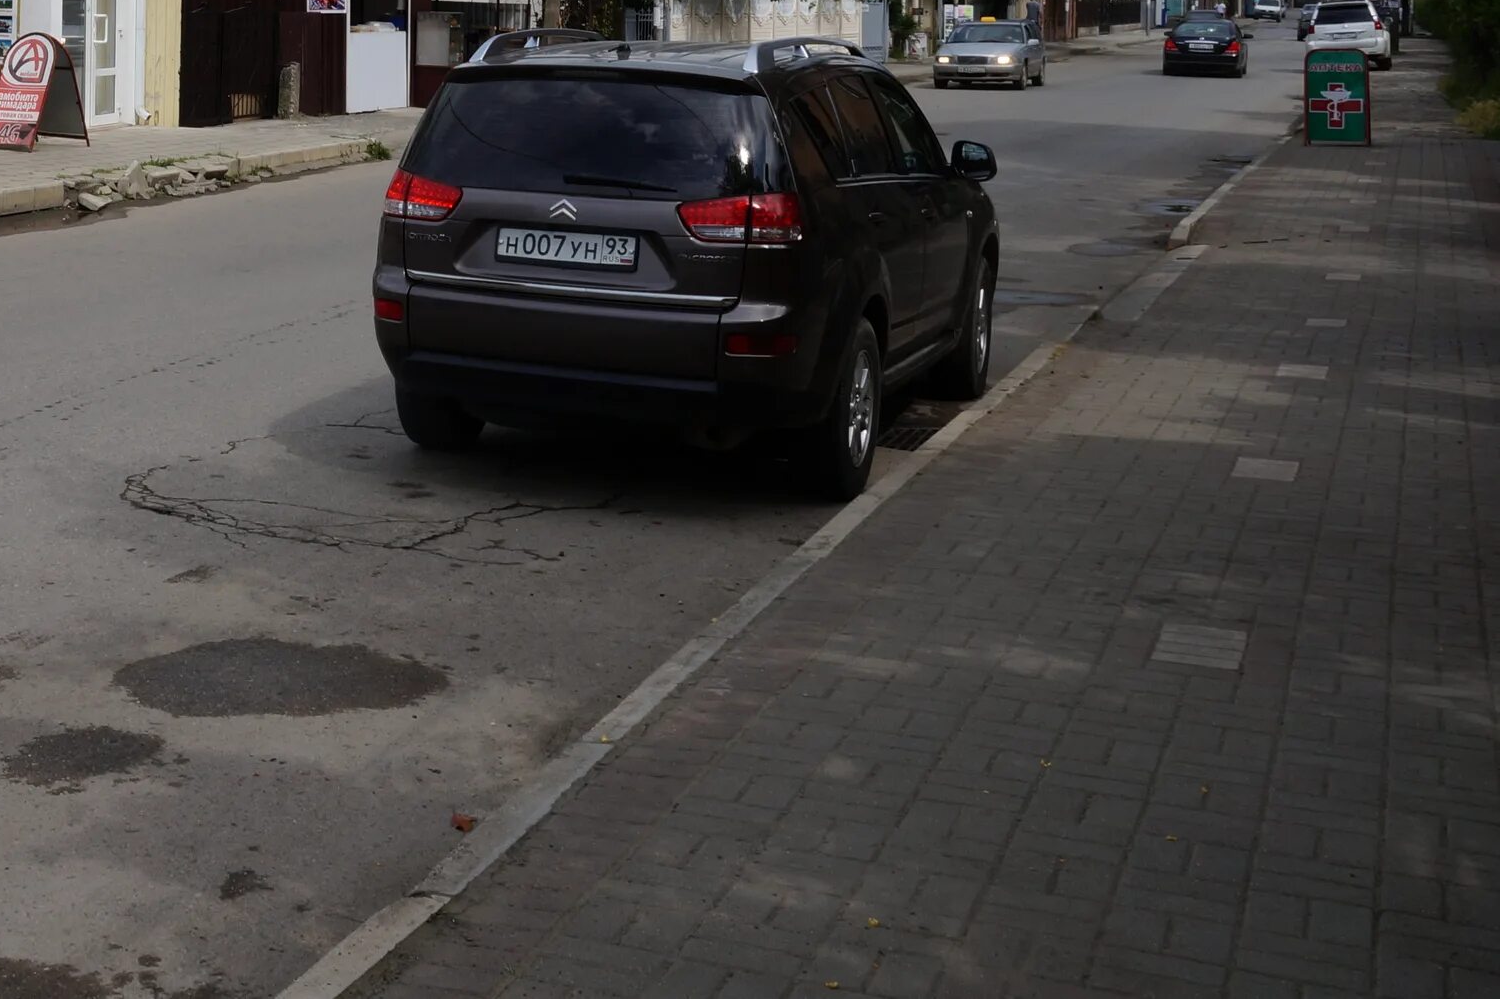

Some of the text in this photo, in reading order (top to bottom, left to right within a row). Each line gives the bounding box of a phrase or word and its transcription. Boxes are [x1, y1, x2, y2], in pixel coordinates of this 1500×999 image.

[1309, 63, 1363, 72] АПТЕКА
[605, 237, 629, 256] 93
[602, 254, 620, 263] RUS
